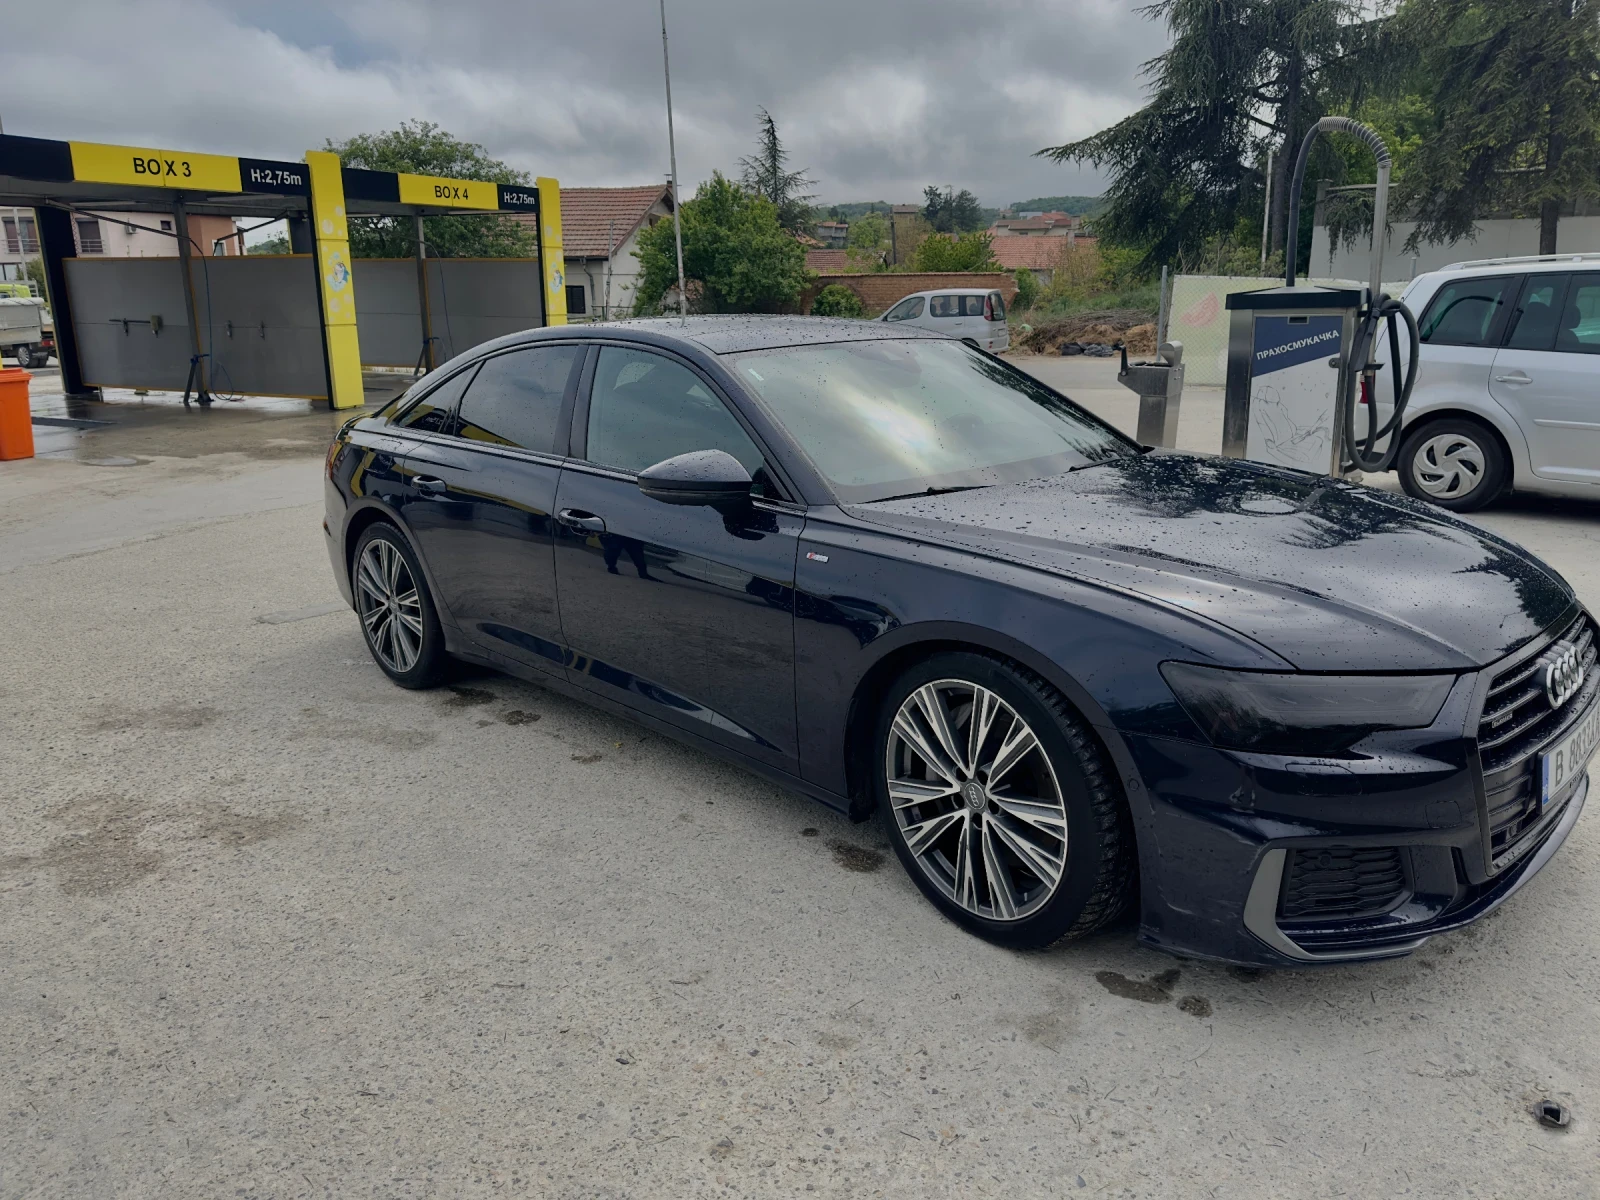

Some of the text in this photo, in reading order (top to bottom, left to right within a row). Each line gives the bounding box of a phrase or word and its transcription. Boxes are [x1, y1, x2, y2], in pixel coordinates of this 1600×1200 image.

[133, 157, 192, 178] BOX 3
[250, 168, 302, 187] H:2,75m
[434, 185, 469, 200] BOX 4
[503, 192, 536, 205] H:2,75m
[1256, 329, 1339, 360] ПРАХОСМУКАЧКА
[1555, 749, 1564, 787] B
